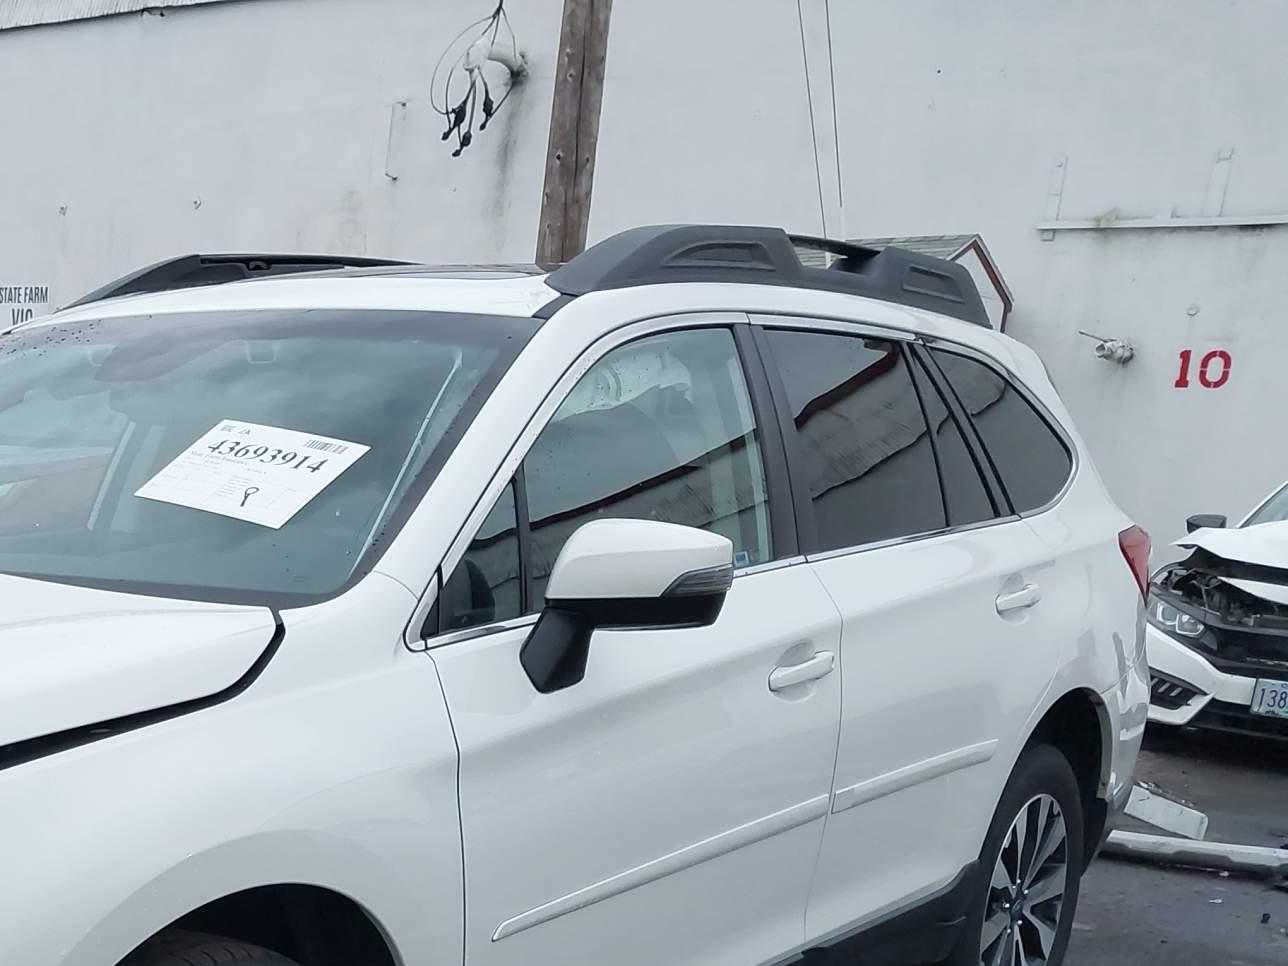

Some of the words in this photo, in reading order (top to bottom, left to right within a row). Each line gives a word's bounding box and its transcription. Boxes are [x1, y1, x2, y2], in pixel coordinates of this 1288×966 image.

[24, 286, 48, 303] FARM
[1174, 349, 1232, 389] 10
[208, 439, 328, 473] 43693914
